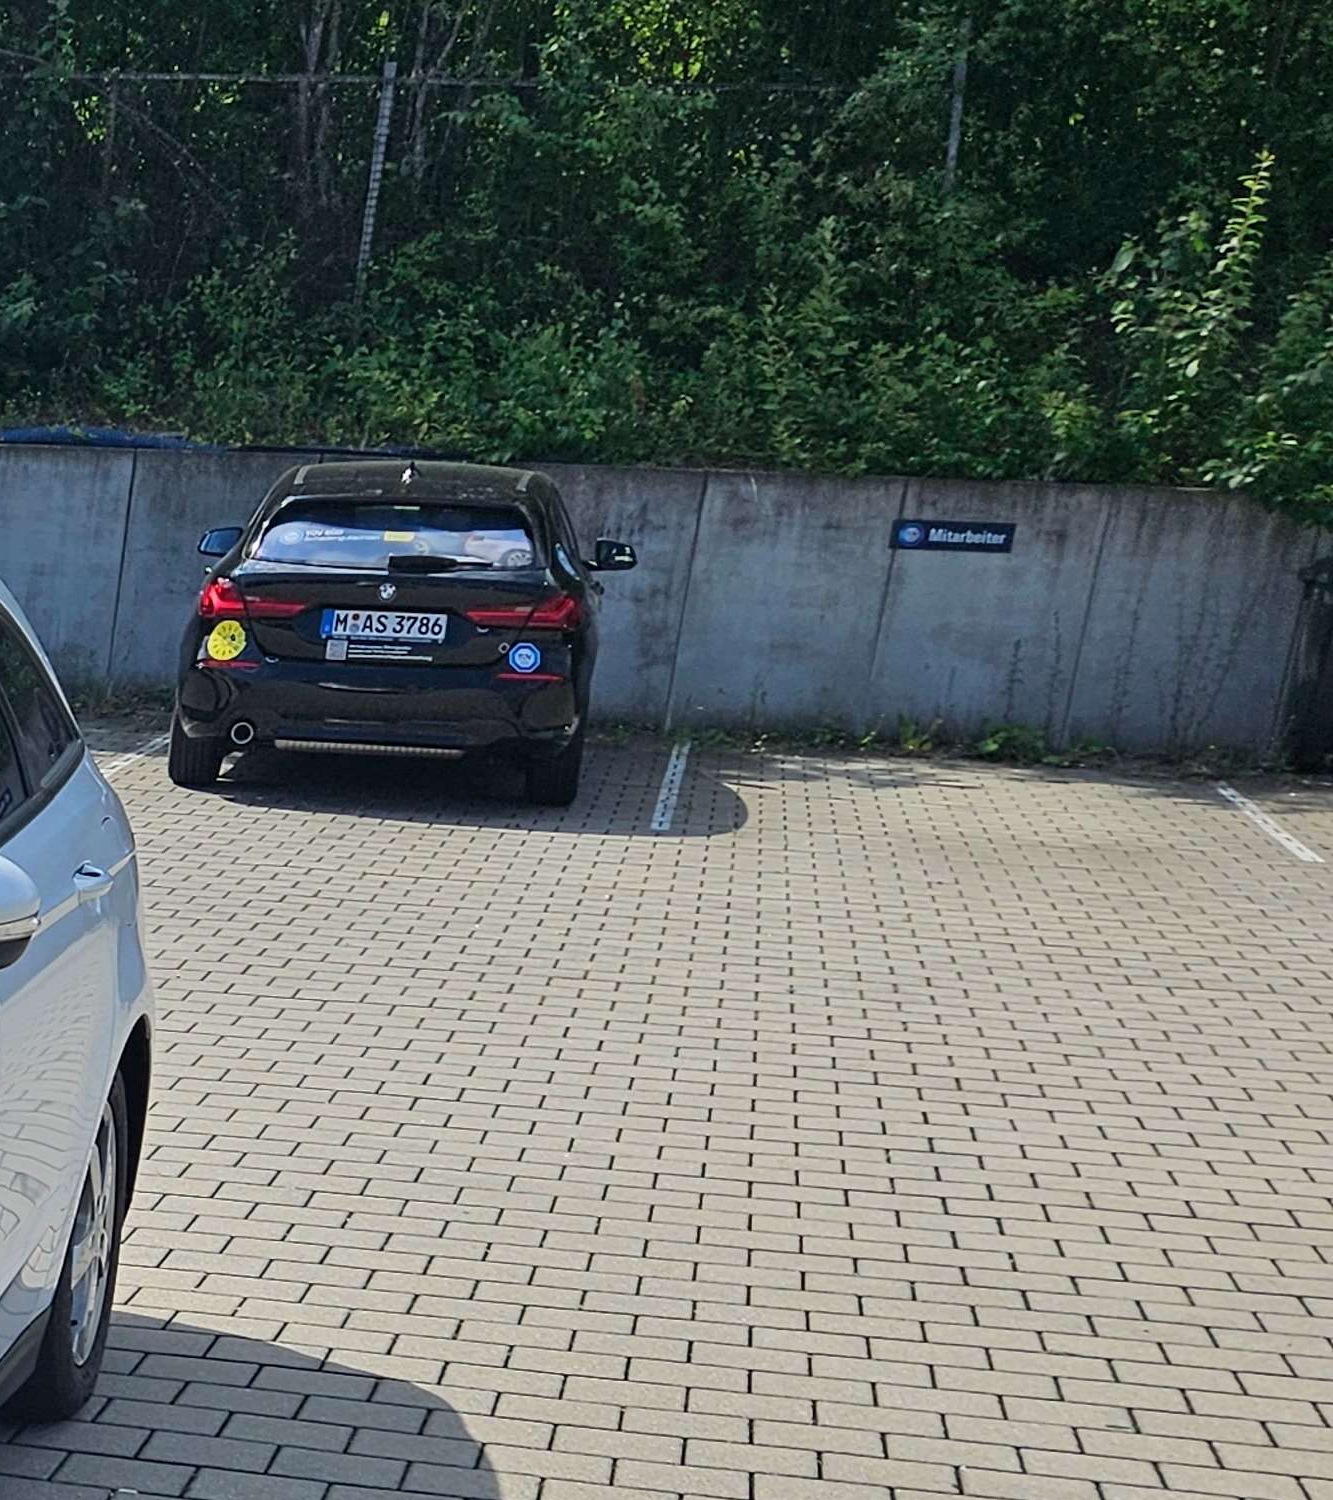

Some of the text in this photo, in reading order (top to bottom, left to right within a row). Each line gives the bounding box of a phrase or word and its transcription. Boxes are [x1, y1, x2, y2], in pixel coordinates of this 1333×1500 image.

[929, 528, 1006, 544] Mitarbeiter
[334, 613, 443, 636] M AS 3786
